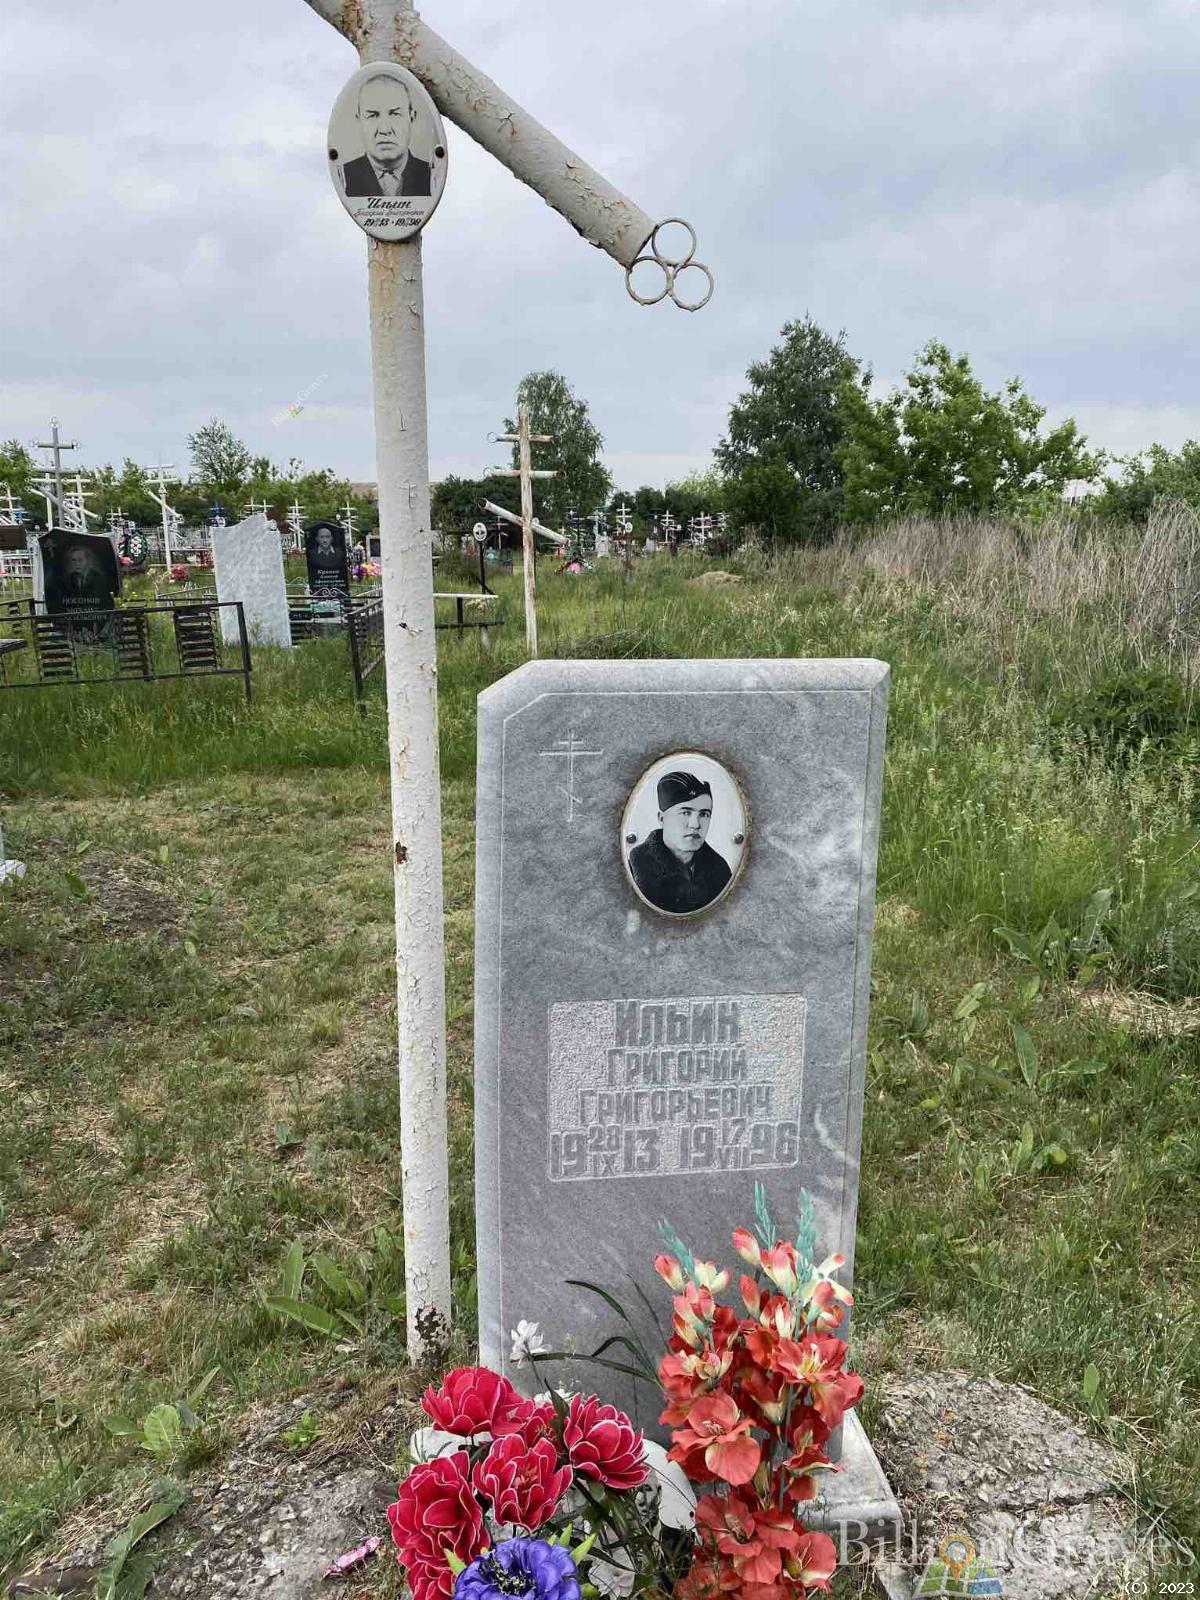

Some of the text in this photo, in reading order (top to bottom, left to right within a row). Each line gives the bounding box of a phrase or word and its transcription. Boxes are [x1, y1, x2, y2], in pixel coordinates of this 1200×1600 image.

[367, 197, 412, 209] Ильин
[615, 1000, 739, 1047] ИЛЬИН
[579, 1086, 769, 1125] ГРИГОРЬЕВИЧ
